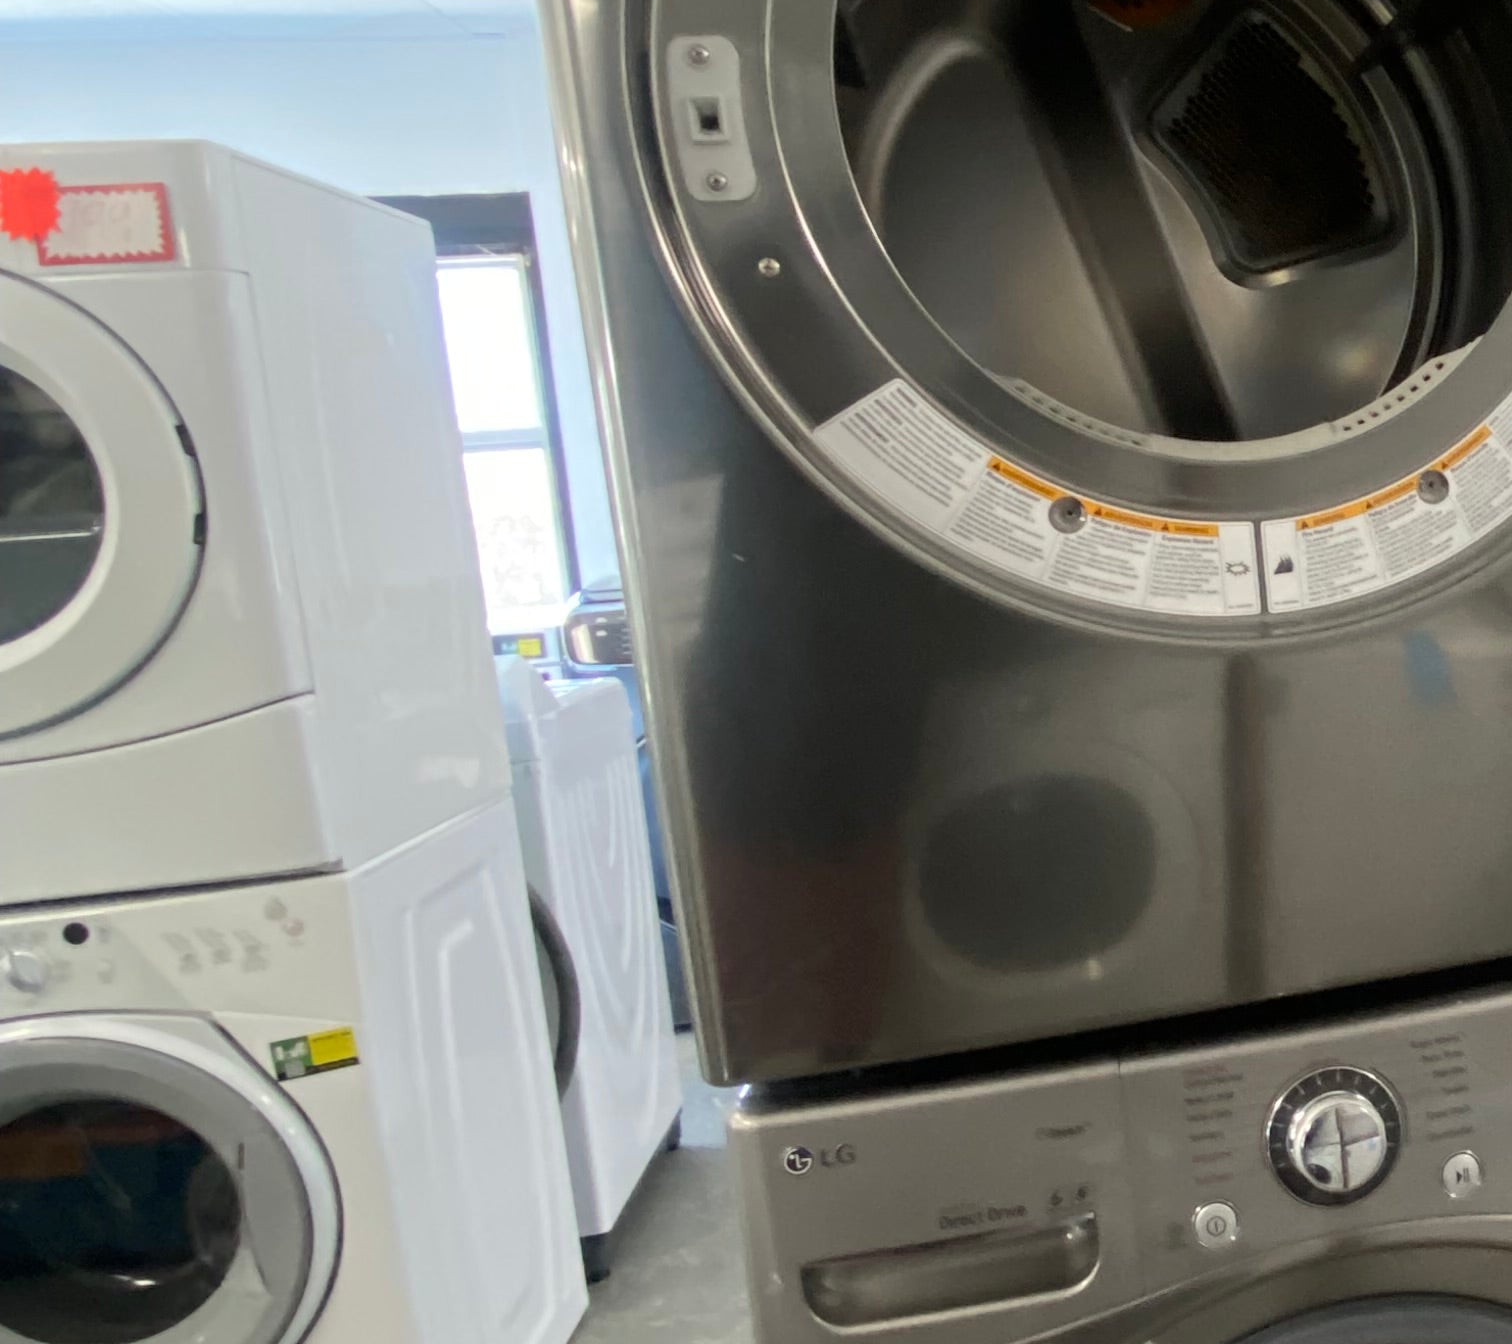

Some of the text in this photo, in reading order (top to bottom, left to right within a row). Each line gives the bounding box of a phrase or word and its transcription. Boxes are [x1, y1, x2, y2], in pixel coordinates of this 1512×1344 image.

[819, 1142, 856, 1168] LG
[938, 1204, 1028, 1230] Direct Drive
